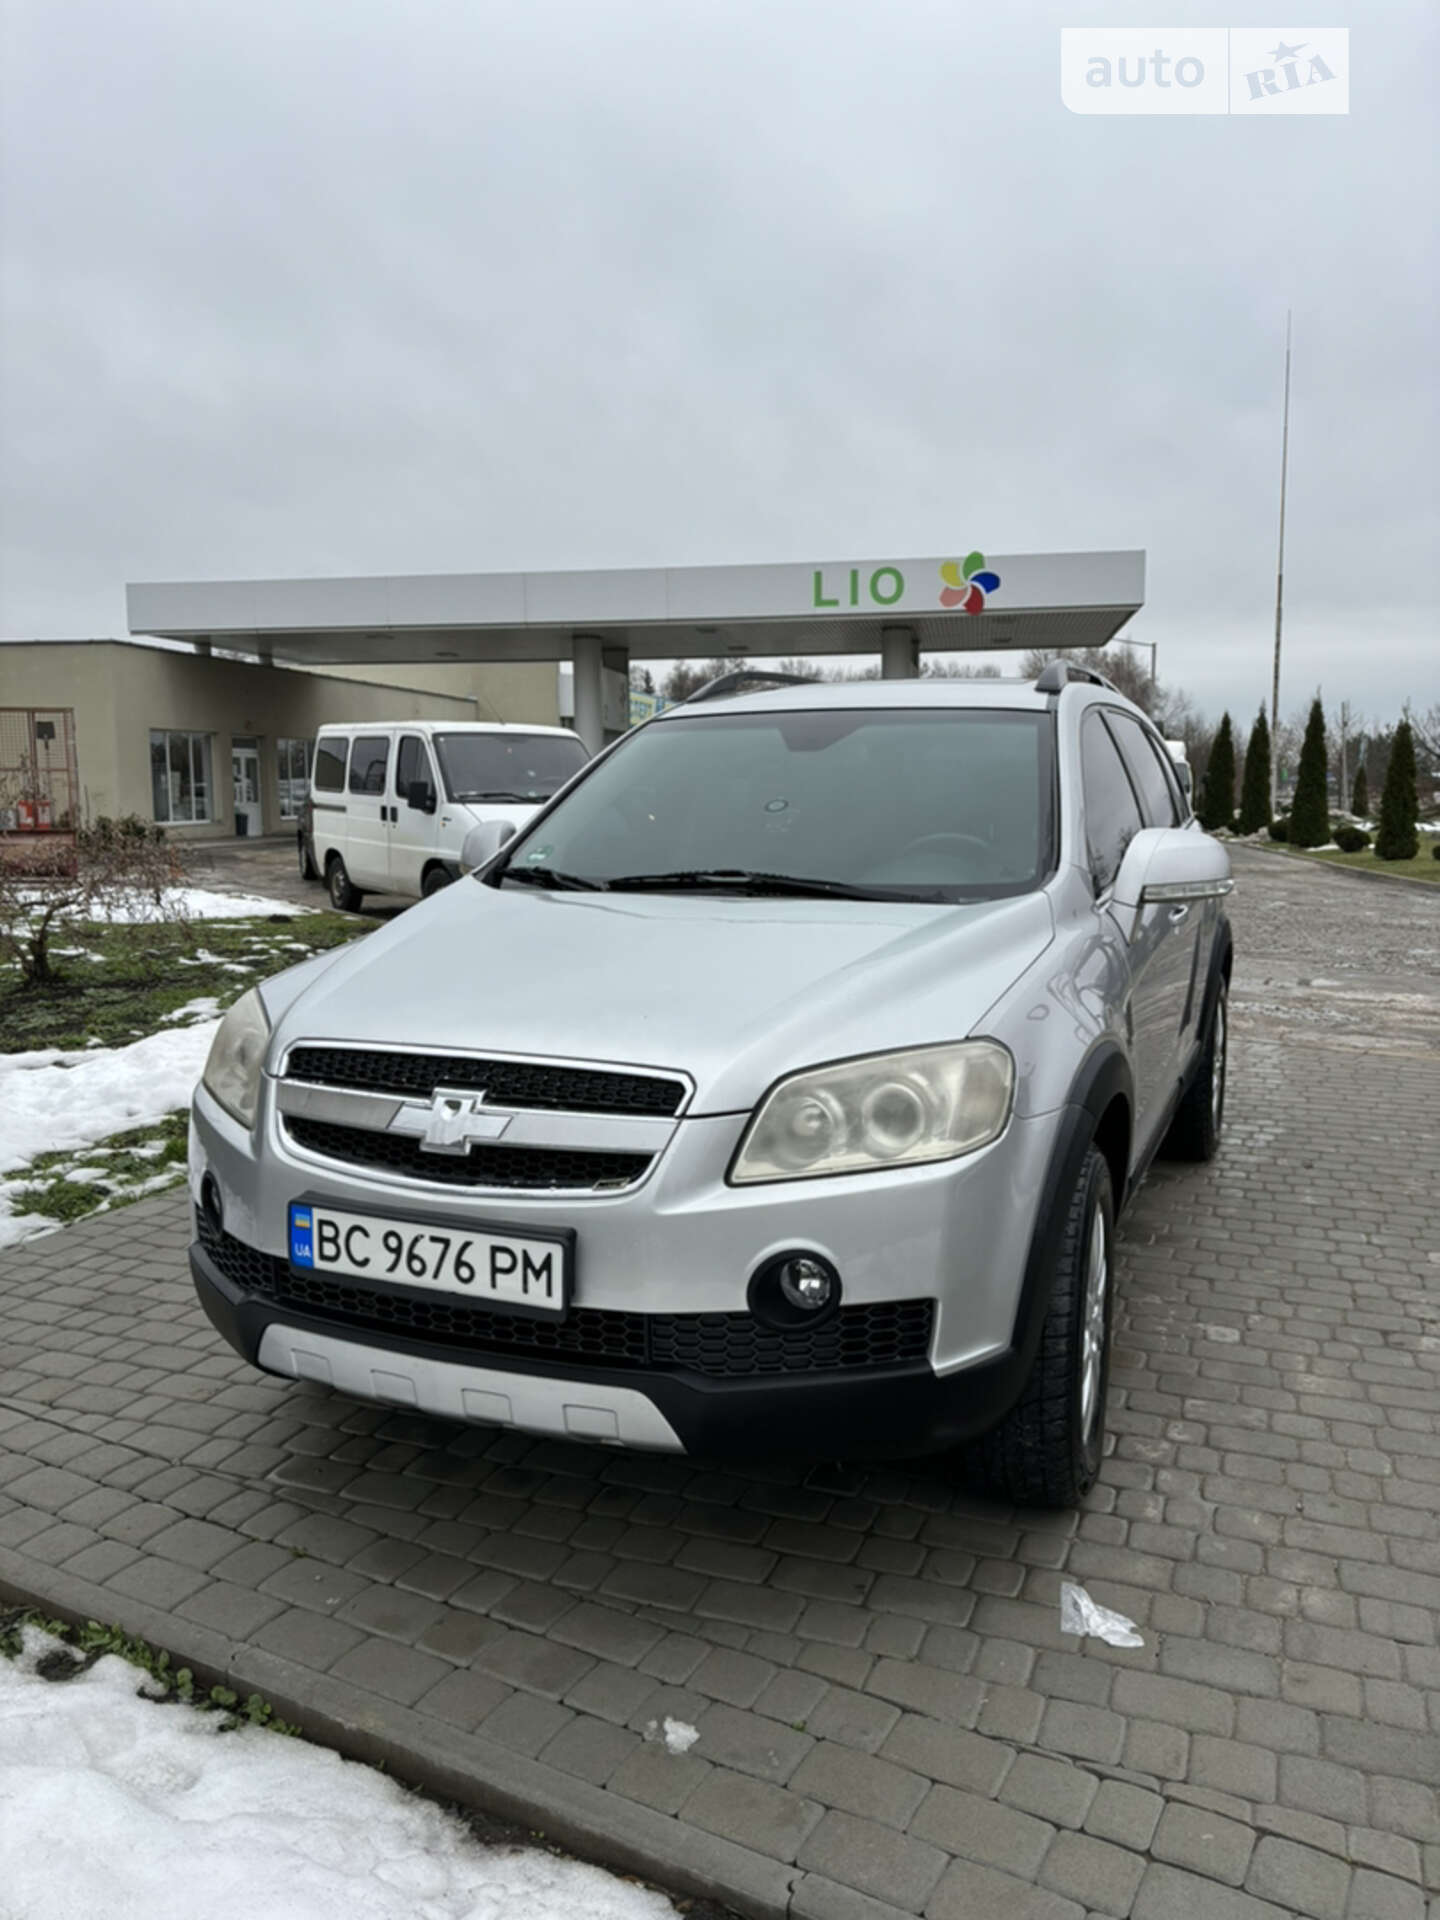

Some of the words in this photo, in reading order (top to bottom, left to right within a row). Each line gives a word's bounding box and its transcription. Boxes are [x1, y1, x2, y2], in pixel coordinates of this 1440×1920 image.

[813, 566, 905, 607] LIO
[294, 1243, 312, 1258] UA
[316, 1218, 371, 1268] BC
[382, 1230, 476, 1285] 9676
[489, 1244, 553, 1298] PM
